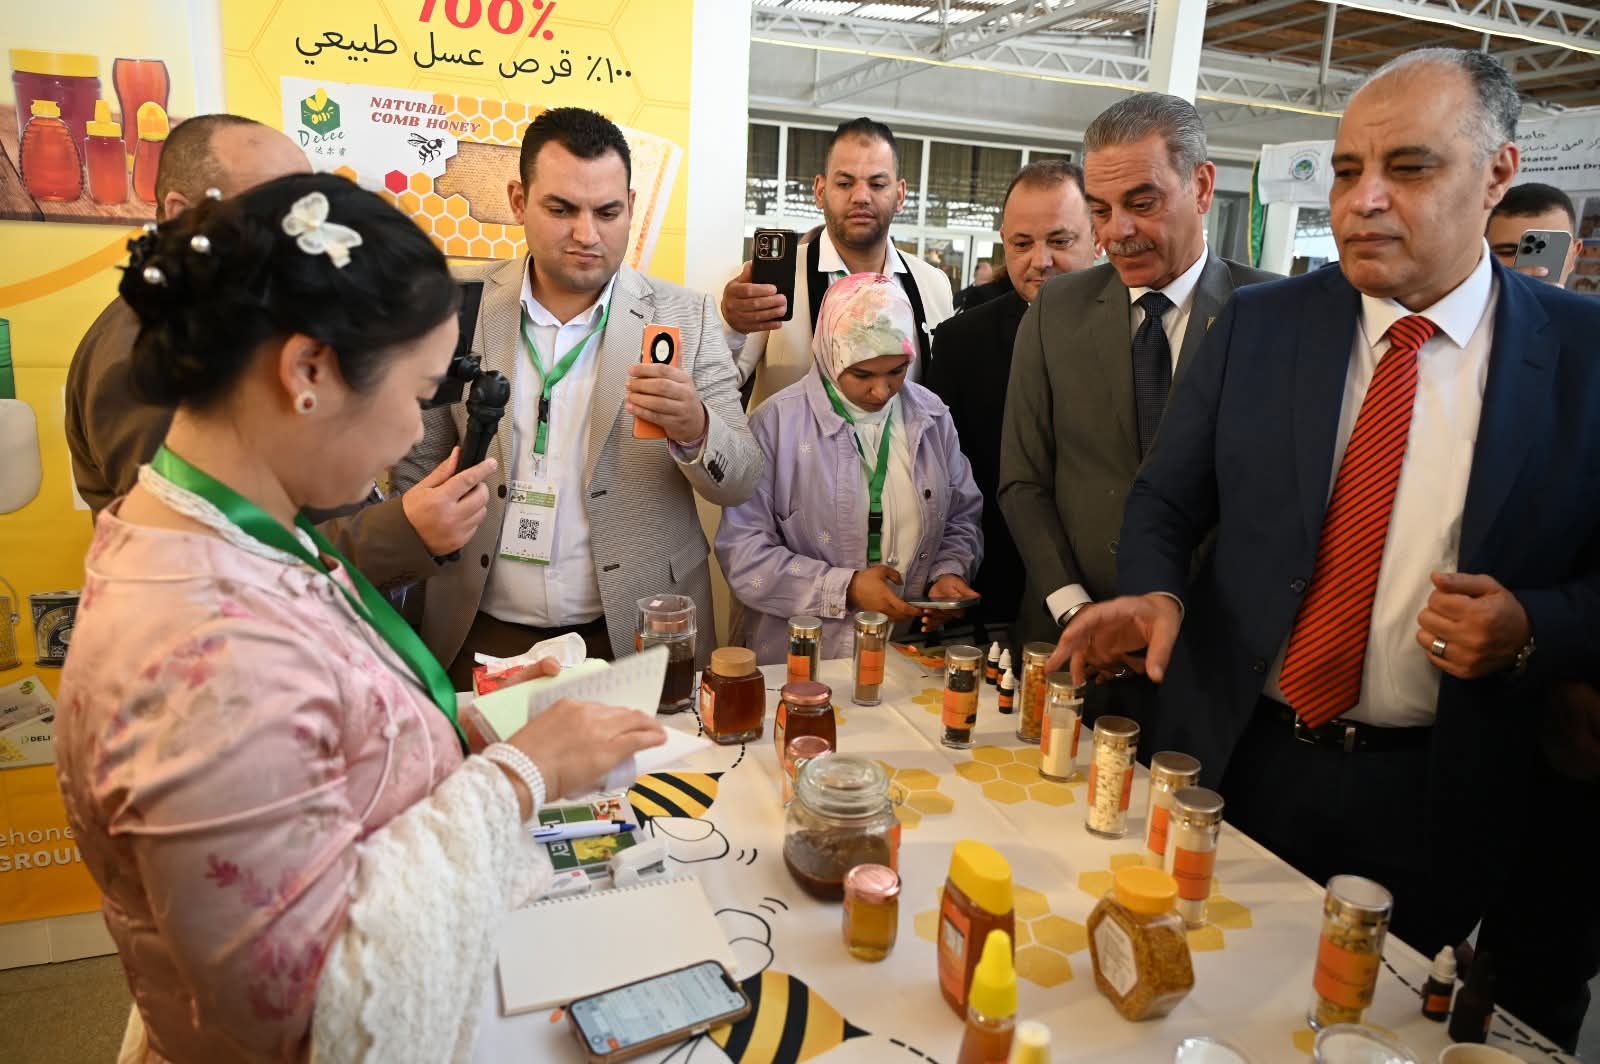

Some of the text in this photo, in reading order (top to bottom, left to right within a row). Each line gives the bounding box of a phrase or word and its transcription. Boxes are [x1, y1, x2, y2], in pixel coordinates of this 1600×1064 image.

[419, 0, 556, 40] 100%
[295, 23, 398, 65] طبيعي
[413, 31, 485, 69] عسل
[498, 49, 573, 85] قرص
[370, 96, 447, 116] NATURAL
[371, 111, 481, 133] COMB HONEY
[0, 826, 76, 847] ehone
